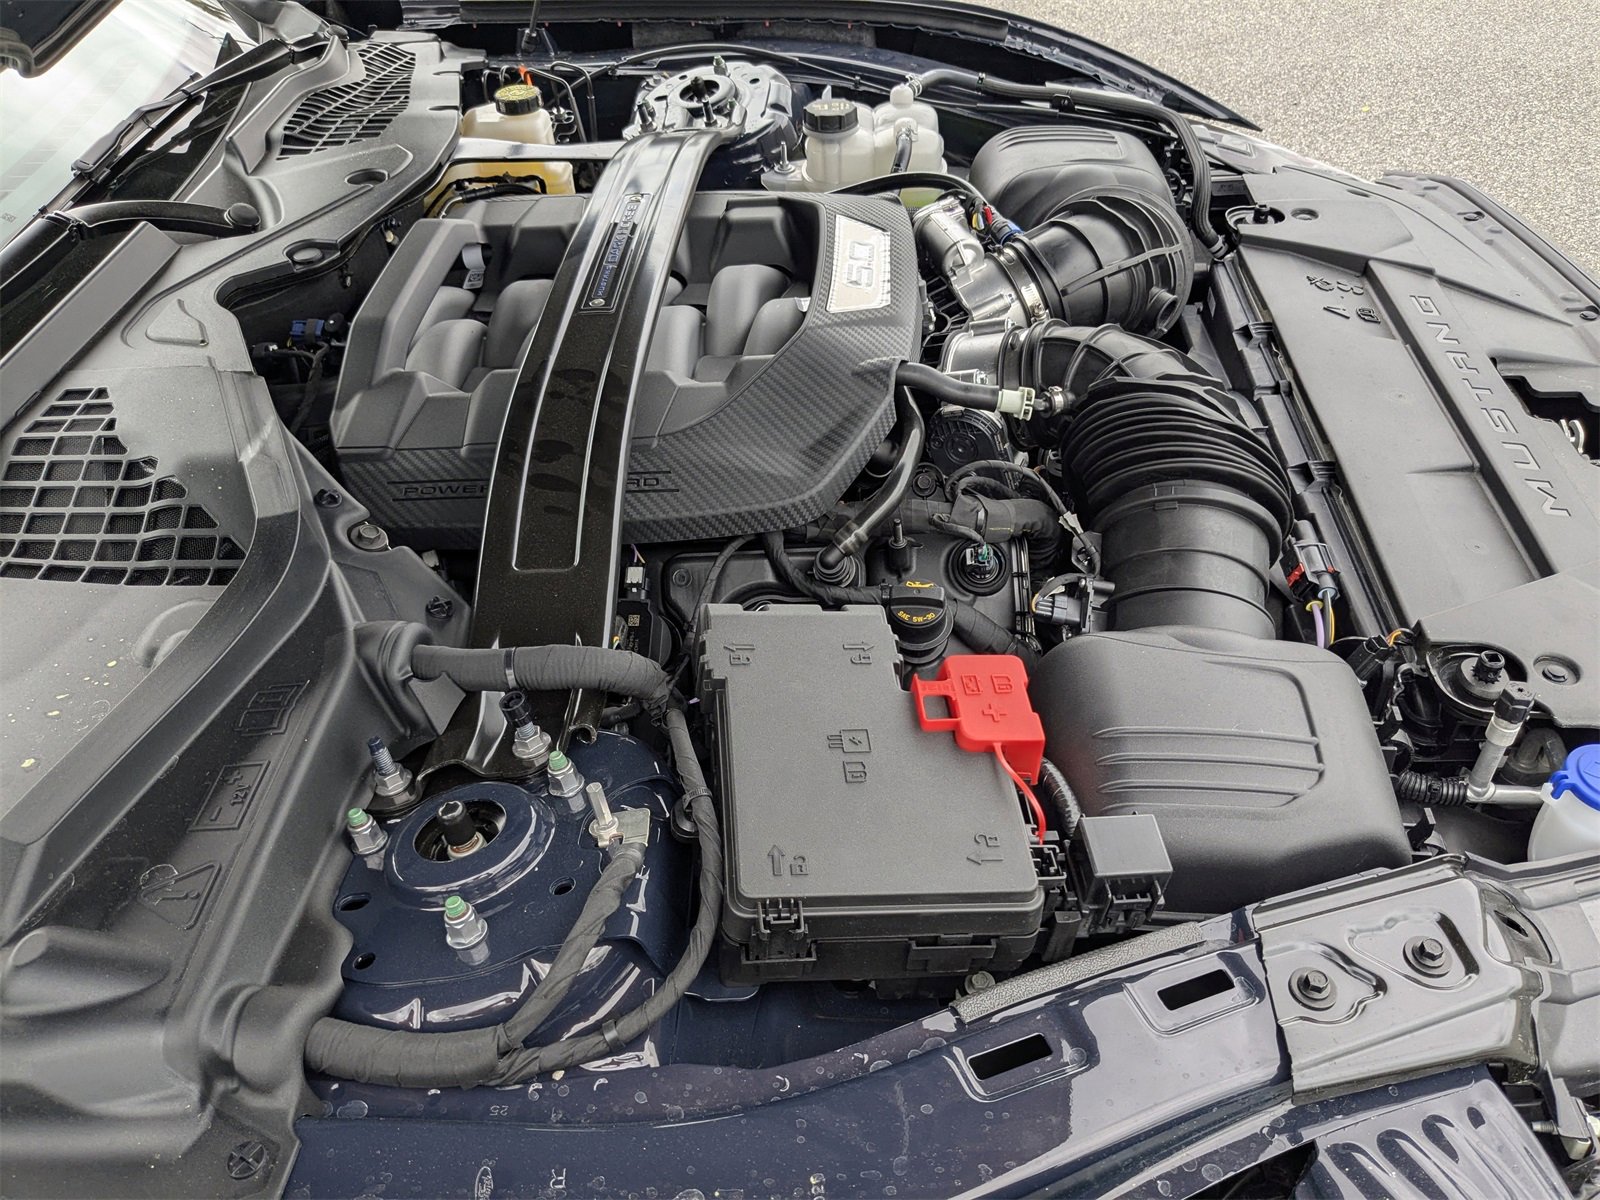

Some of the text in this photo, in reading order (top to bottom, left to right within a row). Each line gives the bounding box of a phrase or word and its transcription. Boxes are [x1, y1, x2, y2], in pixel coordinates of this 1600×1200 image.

[847, 241, 875, 288] 5.0
[1411, 295, 1571, 517] MUSTANG
[897, 610, 936, 623] SAE 5W-30
[230, 785, 250, 806] 12V
[490, 1105, 509, 1116] 25
